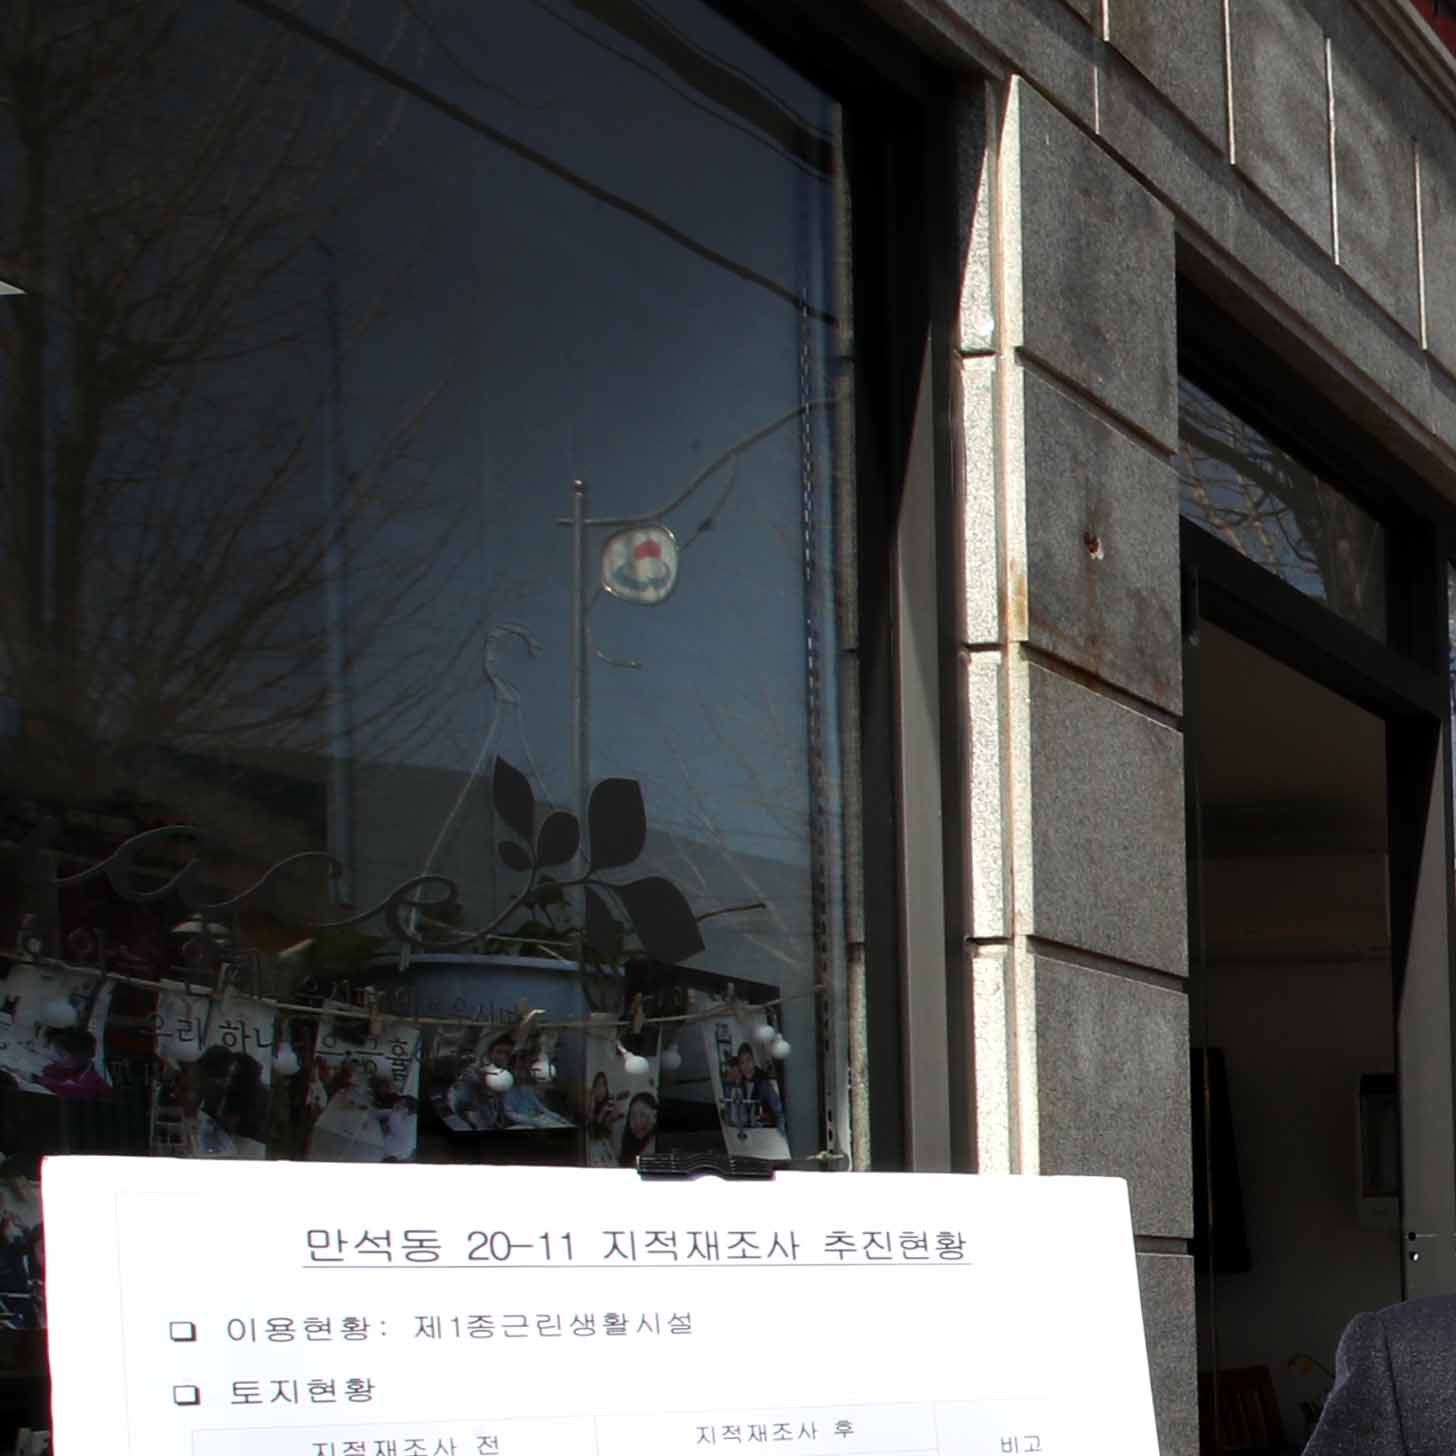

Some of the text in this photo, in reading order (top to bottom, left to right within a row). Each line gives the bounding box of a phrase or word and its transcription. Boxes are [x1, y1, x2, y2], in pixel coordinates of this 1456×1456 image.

[307, 1229, 966, 1262] 만석동 20-11 지적재조사 추진현황
[227, 1312, 691, 1342] 이용현황: 제1종근린생활시설
[232, 1378, 374, 1404] 토지현황
[697, 1420, 854, 1444] 지적재조사 후
[1001, 1435, 1040, 1453] 비고
[477, 1436, 498, 1455] 전
